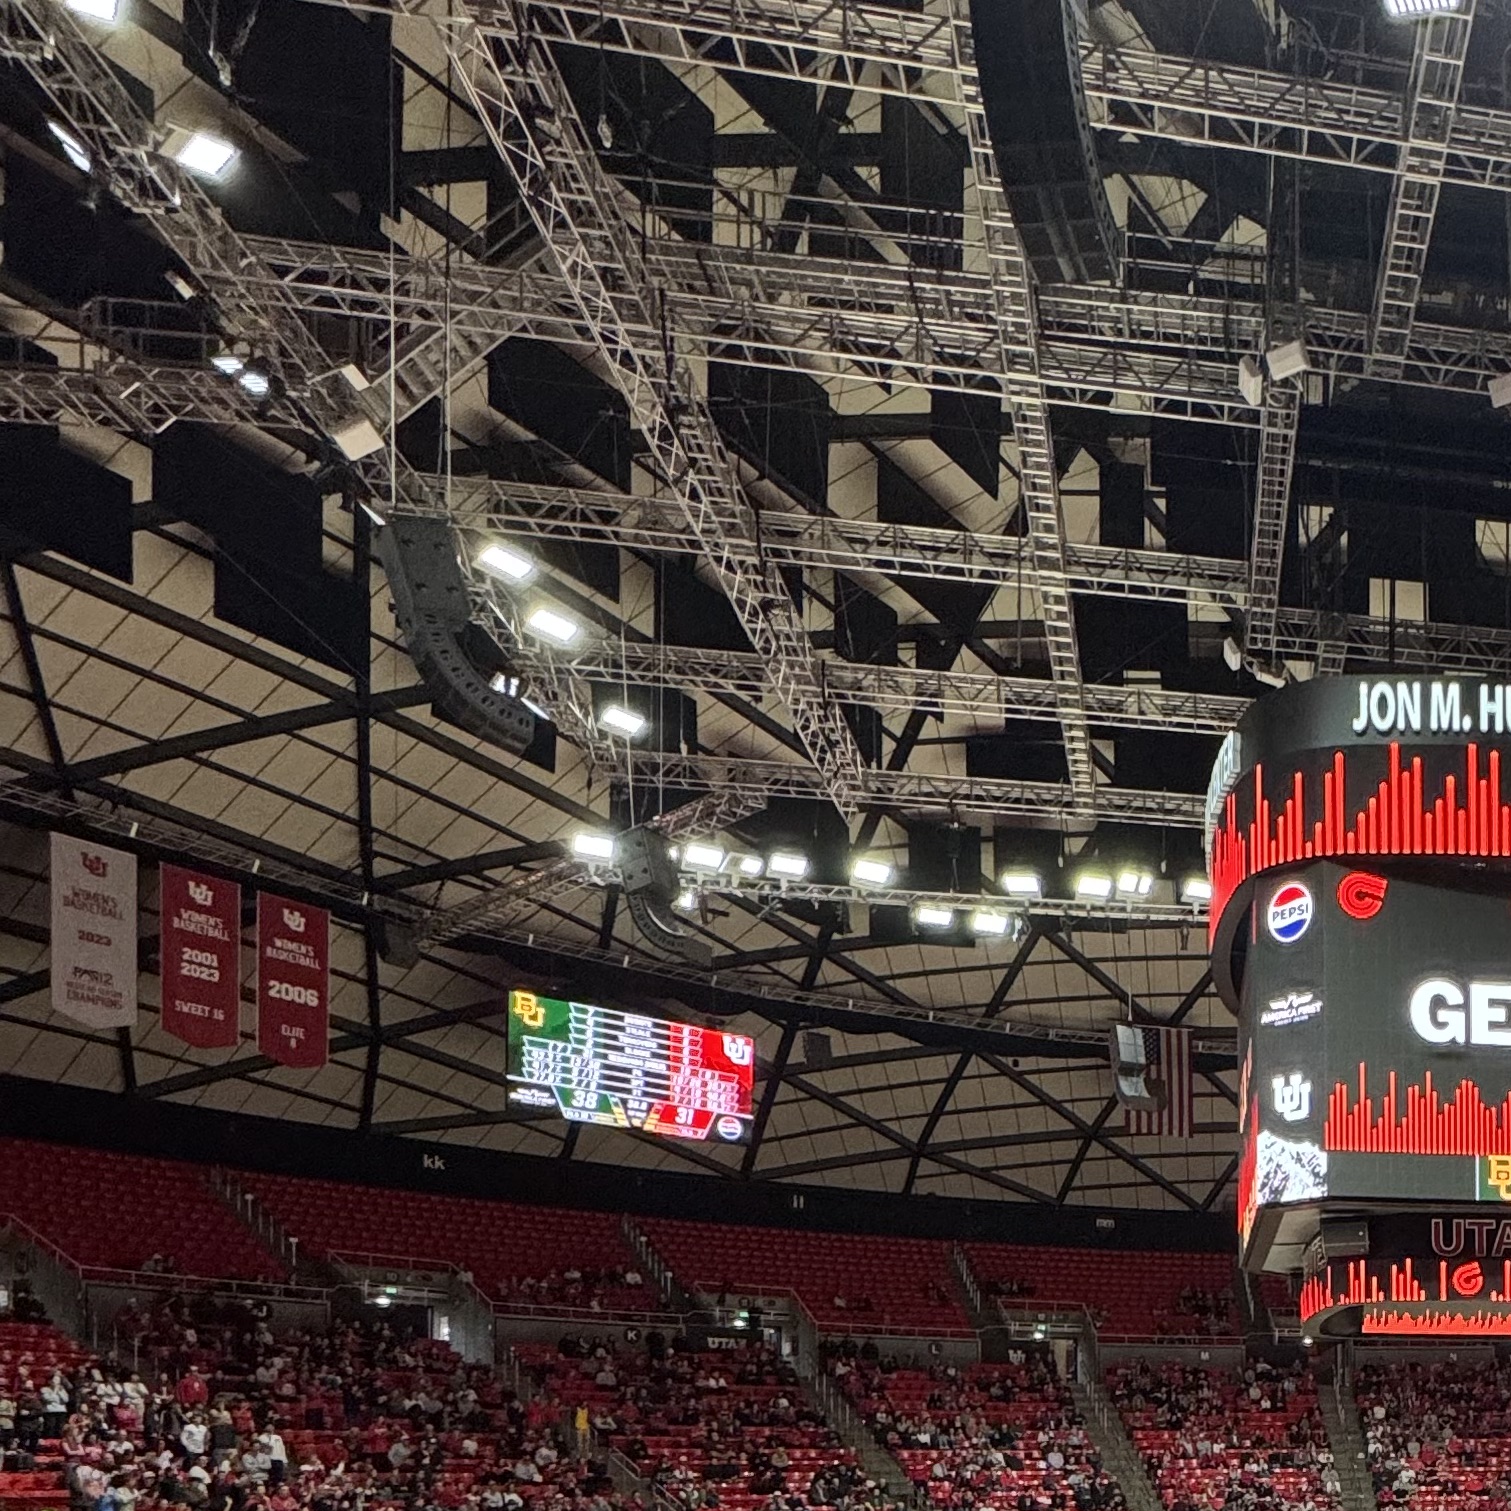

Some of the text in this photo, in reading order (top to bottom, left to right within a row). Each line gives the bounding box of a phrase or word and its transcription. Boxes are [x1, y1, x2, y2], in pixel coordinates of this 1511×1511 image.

[1353, 681, 1422, 732] JON
[1430, 682, 1472, 732] M.
[1272, 904, 1309, 921] PEPSI
[172, 917, 230, 941] BASKETBALL
[182, 947, 219, 967] 2001
[180, 962, 220, 983] 2023
[268, 980, 319, 1007] 2006
[175, 1000, 211, 1018] SWEET
[571, 1090, 598, 1109] 38
[675, 1107, 695, 1124] 31
[423, 1154, 445, 1170] kk
[628, 1331, 637, 1340] K
[1201, 1351, 1209, 1360] M
